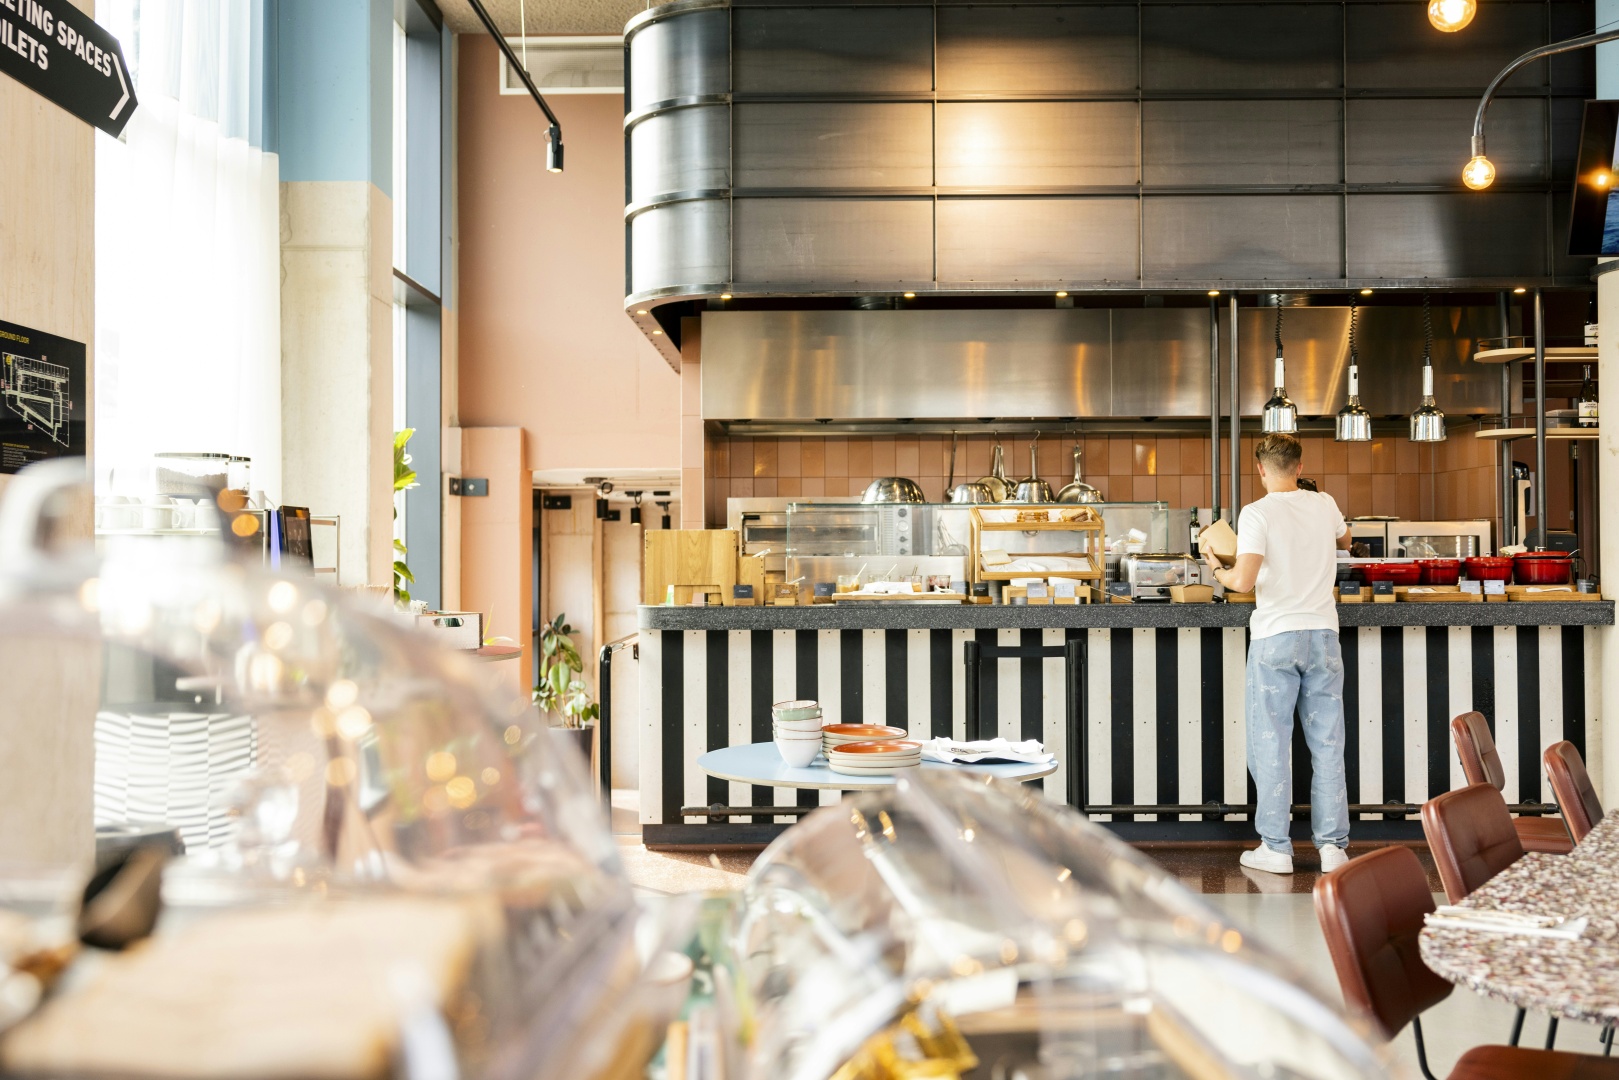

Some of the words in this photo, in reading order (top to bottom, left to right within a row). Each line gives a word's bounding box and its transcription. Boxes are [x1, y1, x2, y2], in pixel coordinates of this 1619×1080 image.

[0, 0, 54, 36] TING
[57, 20, 112, 77] SPACES
[0, 18, 49, 71] ILETS
[16, 334, 30, 344] FLOOR
